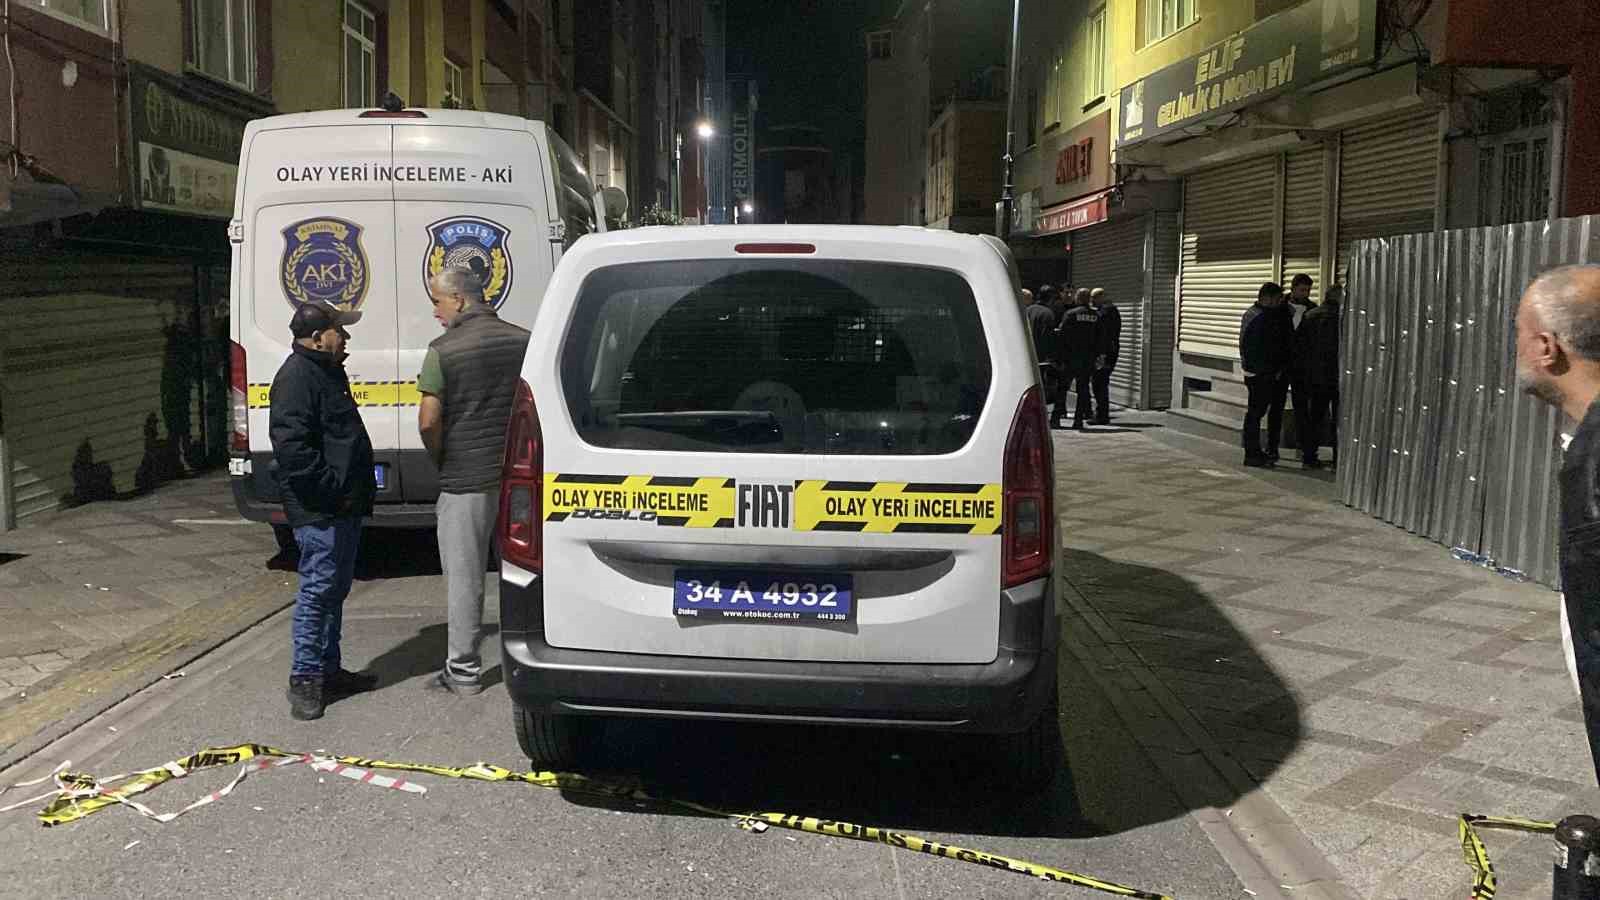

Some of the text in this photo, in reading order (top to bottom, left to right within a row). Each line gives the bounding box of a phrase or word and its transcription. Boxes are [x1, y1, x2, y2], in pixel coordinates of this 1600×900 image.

[276, 167, 323, 182] OLAY
[328, 164, 367, 181] YERİ
[373, 163, 466, 182] İNCELEME
[482, 165, 512, 183] AKİ
[446, 225, 489, 237] POLİS
[302, 259, 346, 282] AKİ
[551, 489, 588, 509] OLAY
[737, 483, 794, 529] FIAT
[826, 495, 865, 516] OLAY
[570, 507, 657, 522] DOBLO
[686, 580, 838, 607] 34 A 4932
